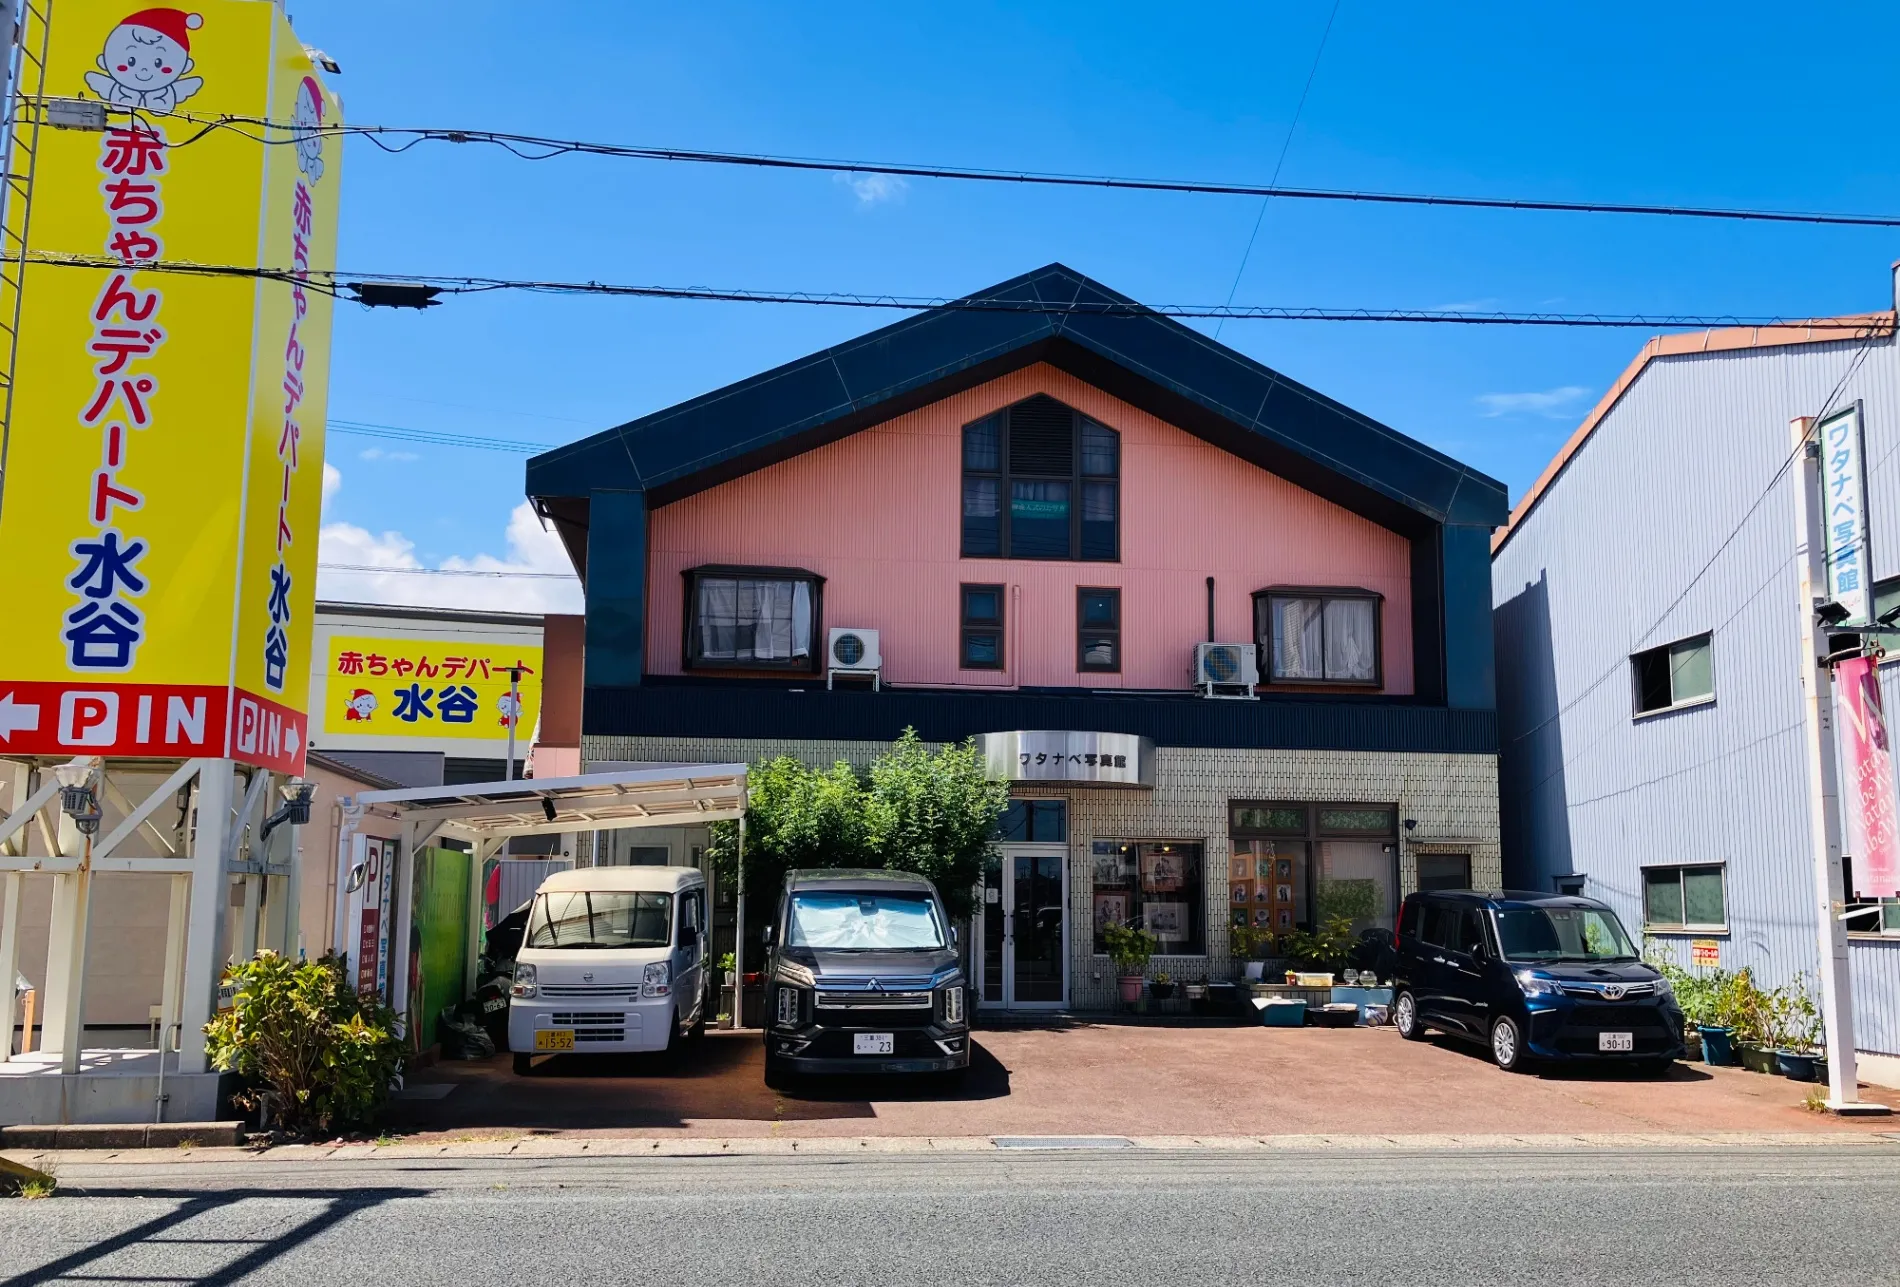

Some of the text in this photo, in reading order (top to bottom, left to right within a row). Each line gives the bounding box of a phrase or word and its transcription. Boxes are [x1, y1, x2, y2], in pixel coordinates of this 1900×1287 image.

[1828, 422, 1860, 595] ワタナベ写真館
[337, 651, 535, 682] 赤ちゃんデパート
[392, 683, 479, 723] 水谷
[1019, 752, 1127, 768] ワタナベ写真館
[367, 846, 379, 903] P
[545, 1037, 572, 1049] 15-52
[1606, 1039, 1631, 1050] 90-13
